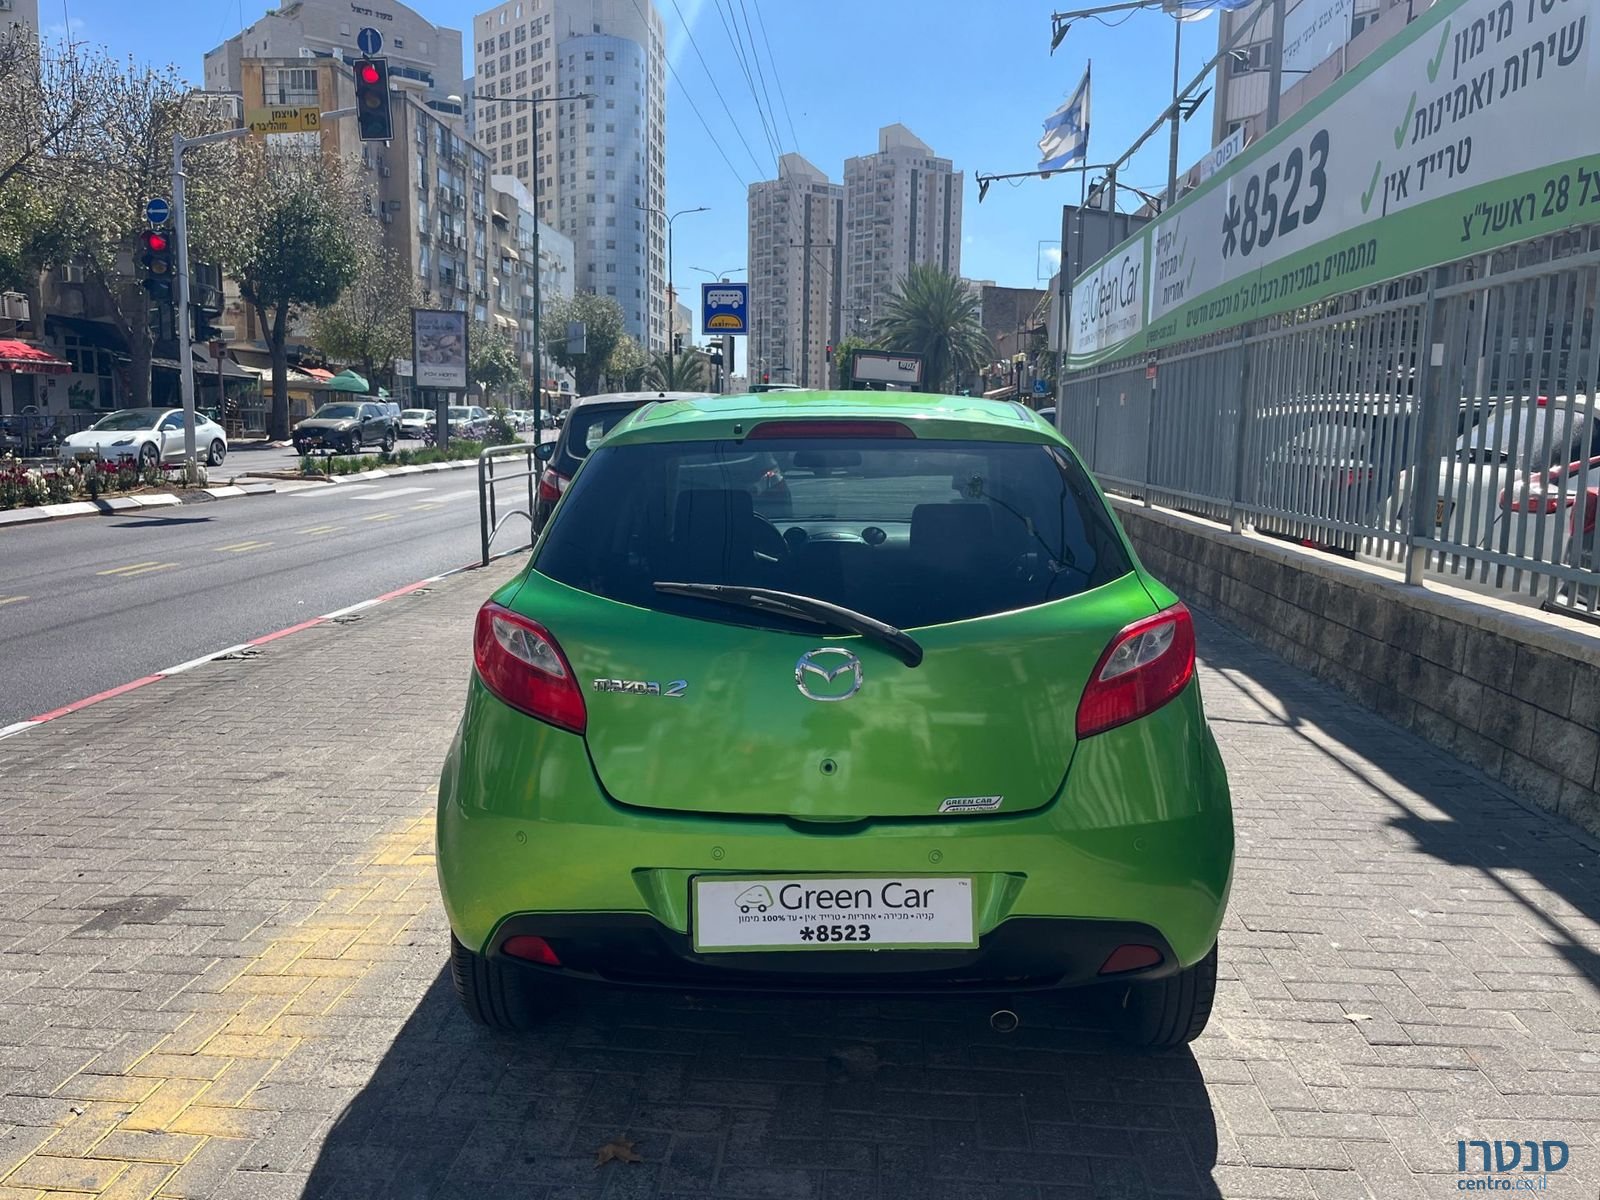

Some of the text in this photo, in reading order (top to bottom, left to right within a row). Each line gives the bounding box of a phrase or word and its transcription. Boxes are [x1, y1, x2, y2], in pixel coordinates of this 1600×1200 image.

[1453, 0, 1514, 80] מימון
[1411, 15, 1586, 145] שירות ואמינות
[271, 110, 293, 121] ויצמן
[304, 113, 317, 125] 13
[1216, 135, 1239, 167] דפוס
[1382, 136, 1472, 217] טרייד אין
[1541, 174, 1570, 217] 28
[1160, 255, 1177, 280] מכירה
[1322, 239, 1376, 281] מתמחים
[1090, 255, 1141, 323] Green Car
[1162, 280, 1185, 305] אחריות
[1280, 261, 1320, 298] במכירת
[1186, 305, 1208, 328] חדשים
[779, 882, 934, 910] Green Car
[738, 915, 760, 924] מימון
[804, 914, 817, 922] אין
[916, 912, 935, 920] קניה
